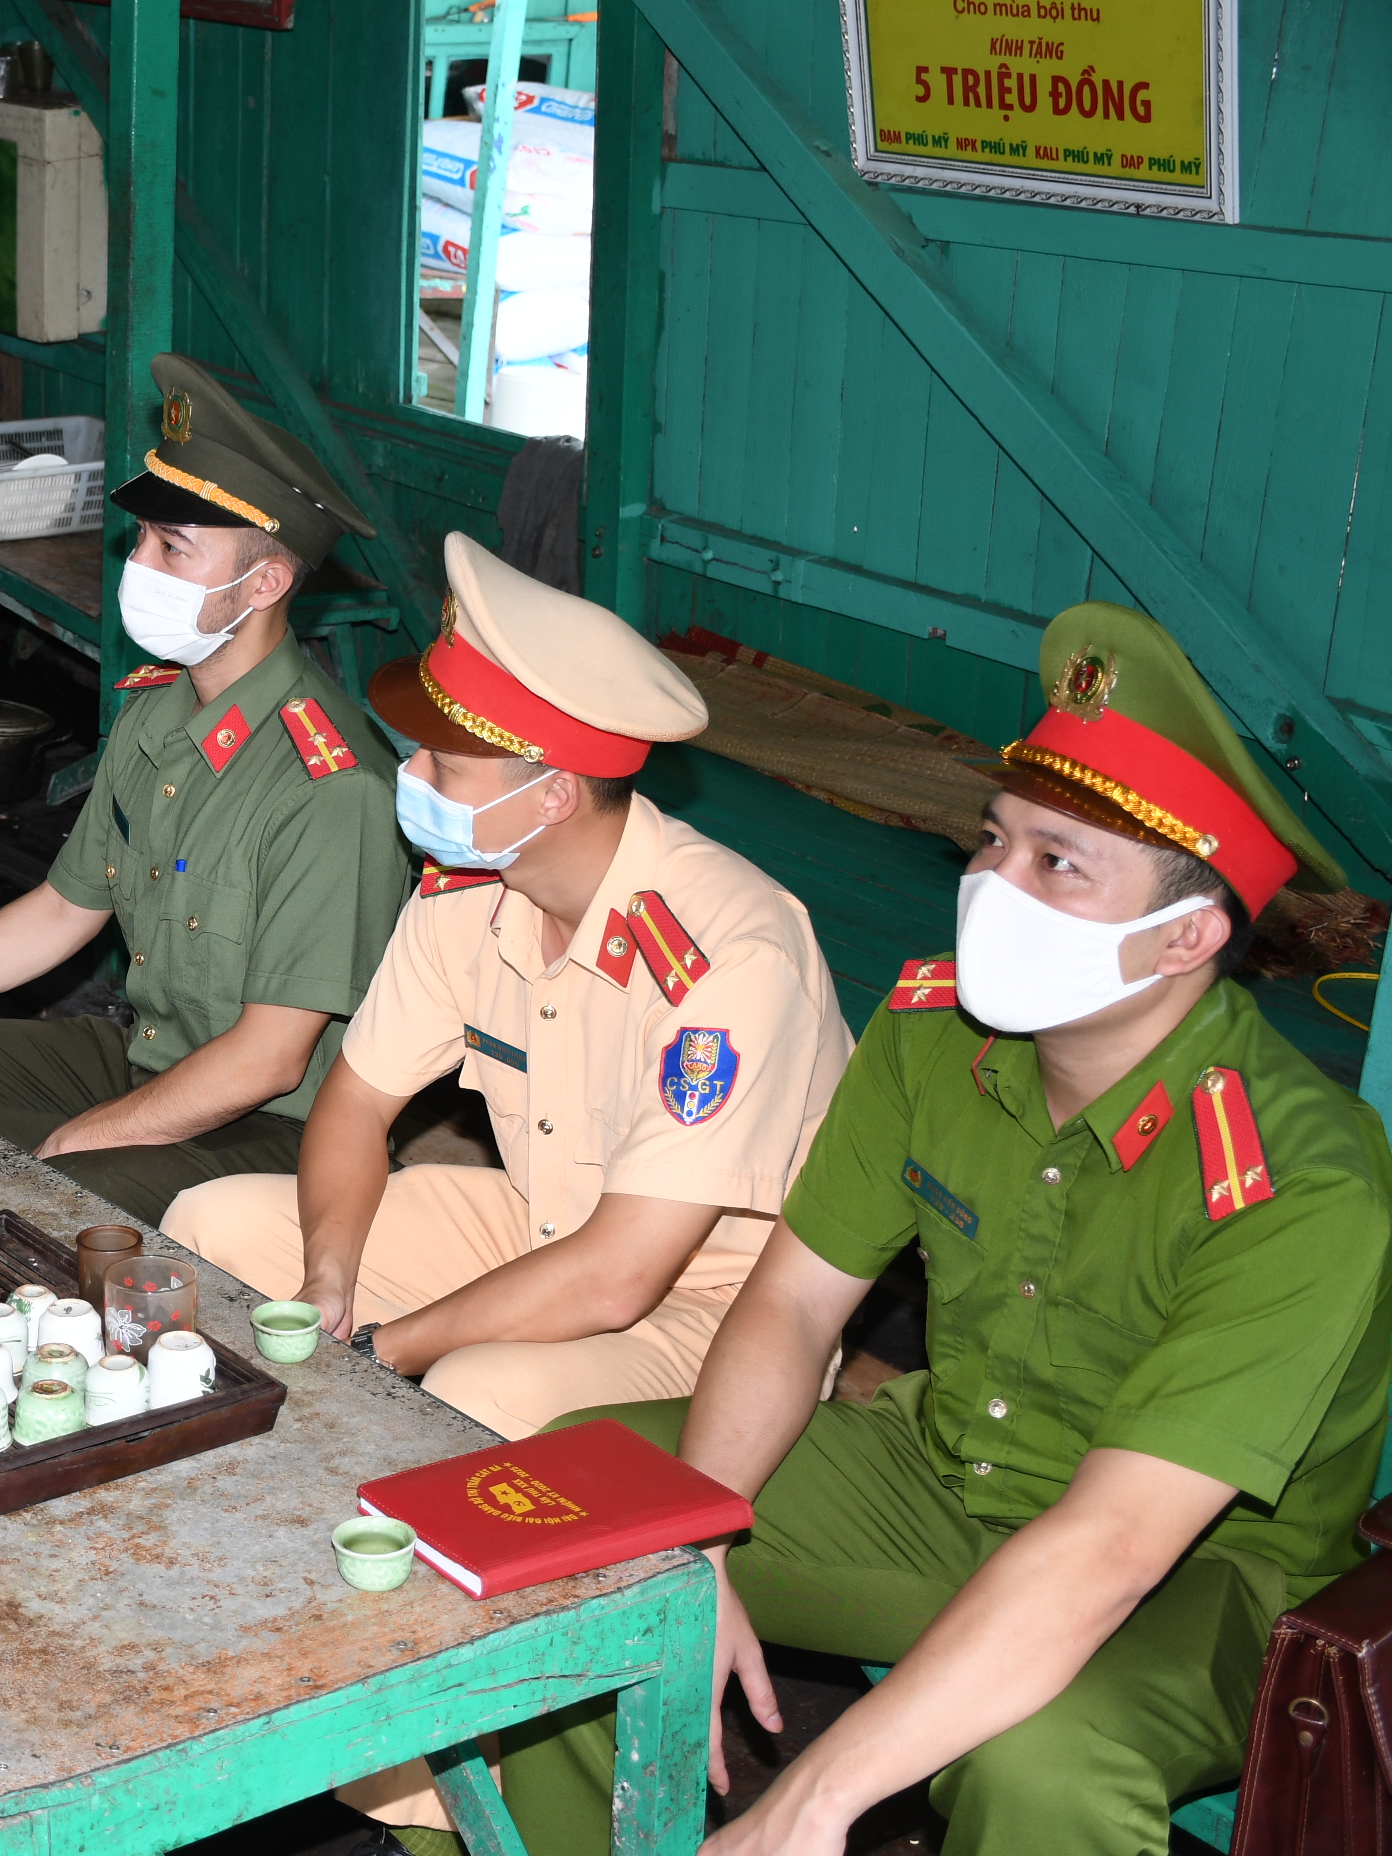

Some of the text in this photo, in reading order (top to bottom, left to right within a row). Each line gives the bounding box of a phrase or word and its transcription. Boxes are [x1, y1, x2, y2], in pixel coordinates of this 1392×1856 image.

[953, 0, 1101, 23] Cho mùa bội thu
[989, 34, 1065, 63] KÍNH TẶNG
[914, 63, 1153, 123] 5 TRIỆU ĐỒNG
[879, 129, 1202, 176] ĐẠM PHÚ MỸ NPK PHÚ MỸ KALI PHÚ MỸ DAP PHÚ MỸ
[530, 1480, 551, 1493] 2020
